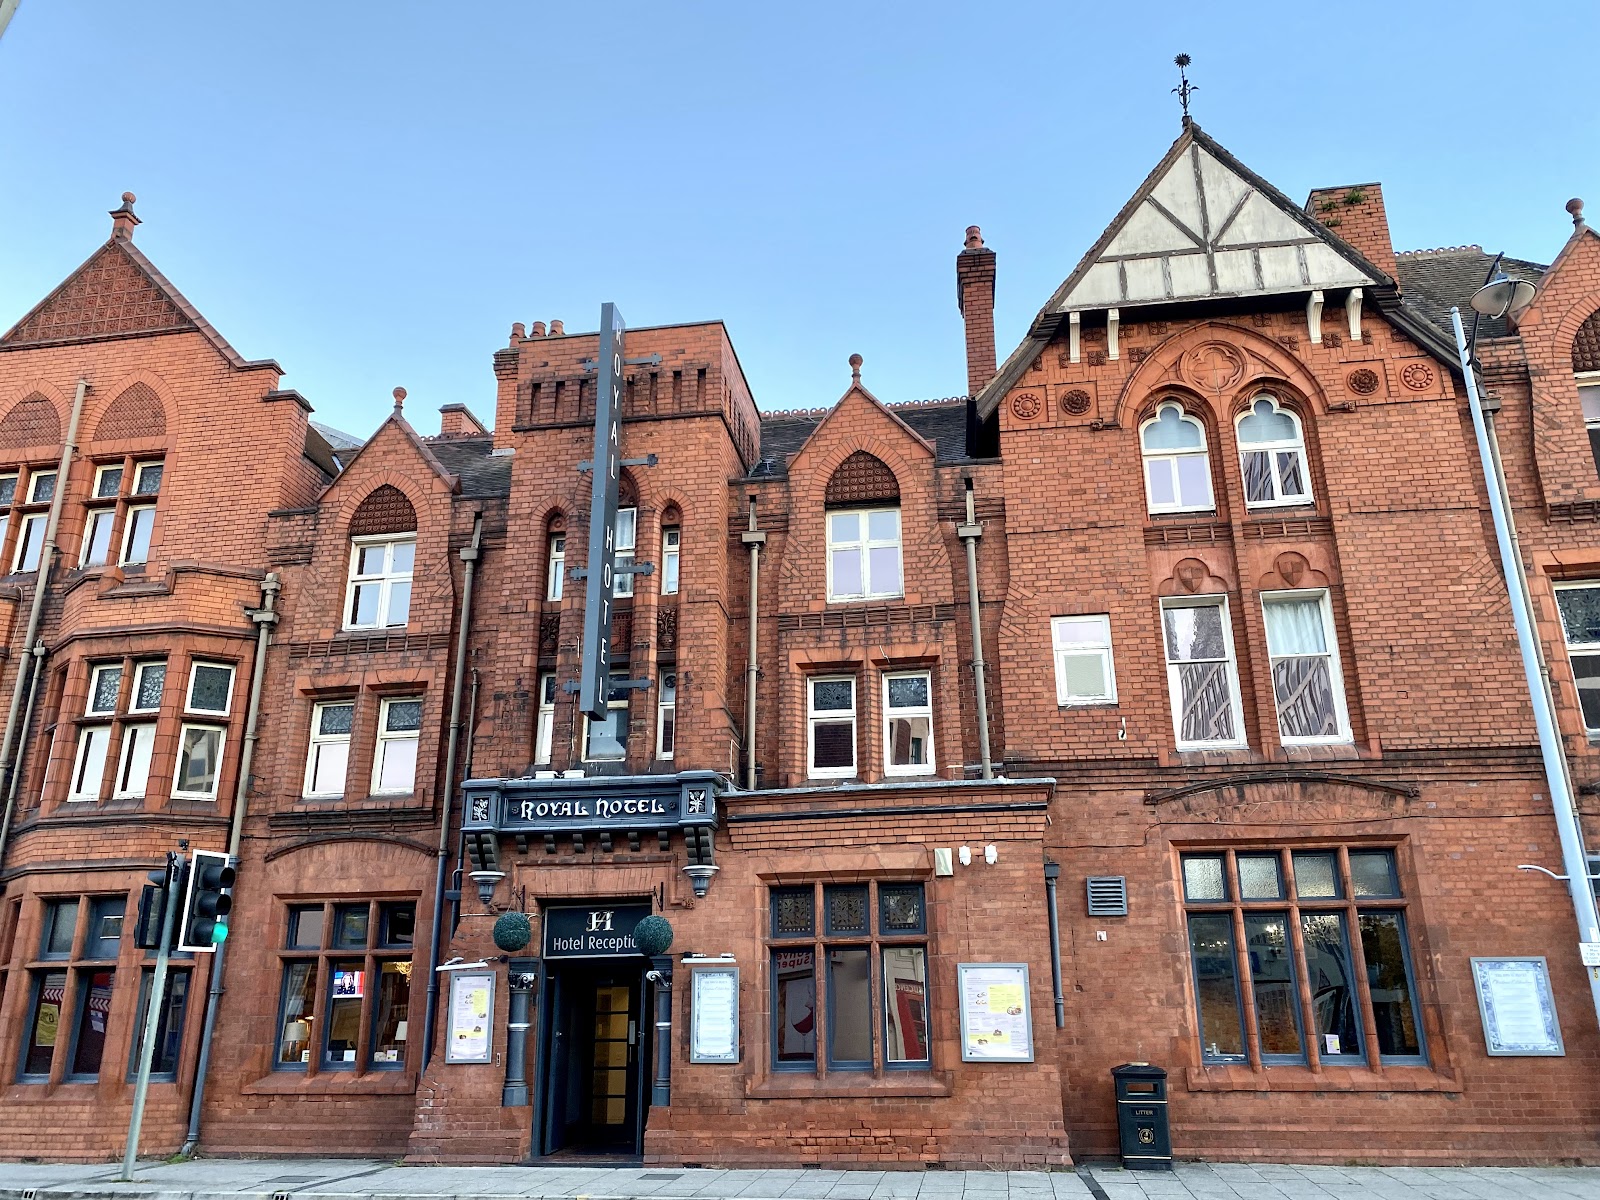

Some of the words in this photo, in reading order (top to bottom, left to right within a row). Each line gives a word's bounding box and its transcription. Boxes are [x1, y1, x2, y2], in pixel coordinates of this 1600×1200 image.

[610, 320, 622, 480] ROYAL
[598, 525, 614, 705] HOTEL
[520, 799, 590, 821] ROYAL
[595, 797, 666, 819] HOTEL
[553, 934, 584, 951] Hotel
[588, 933, 637, 953] Recepti
